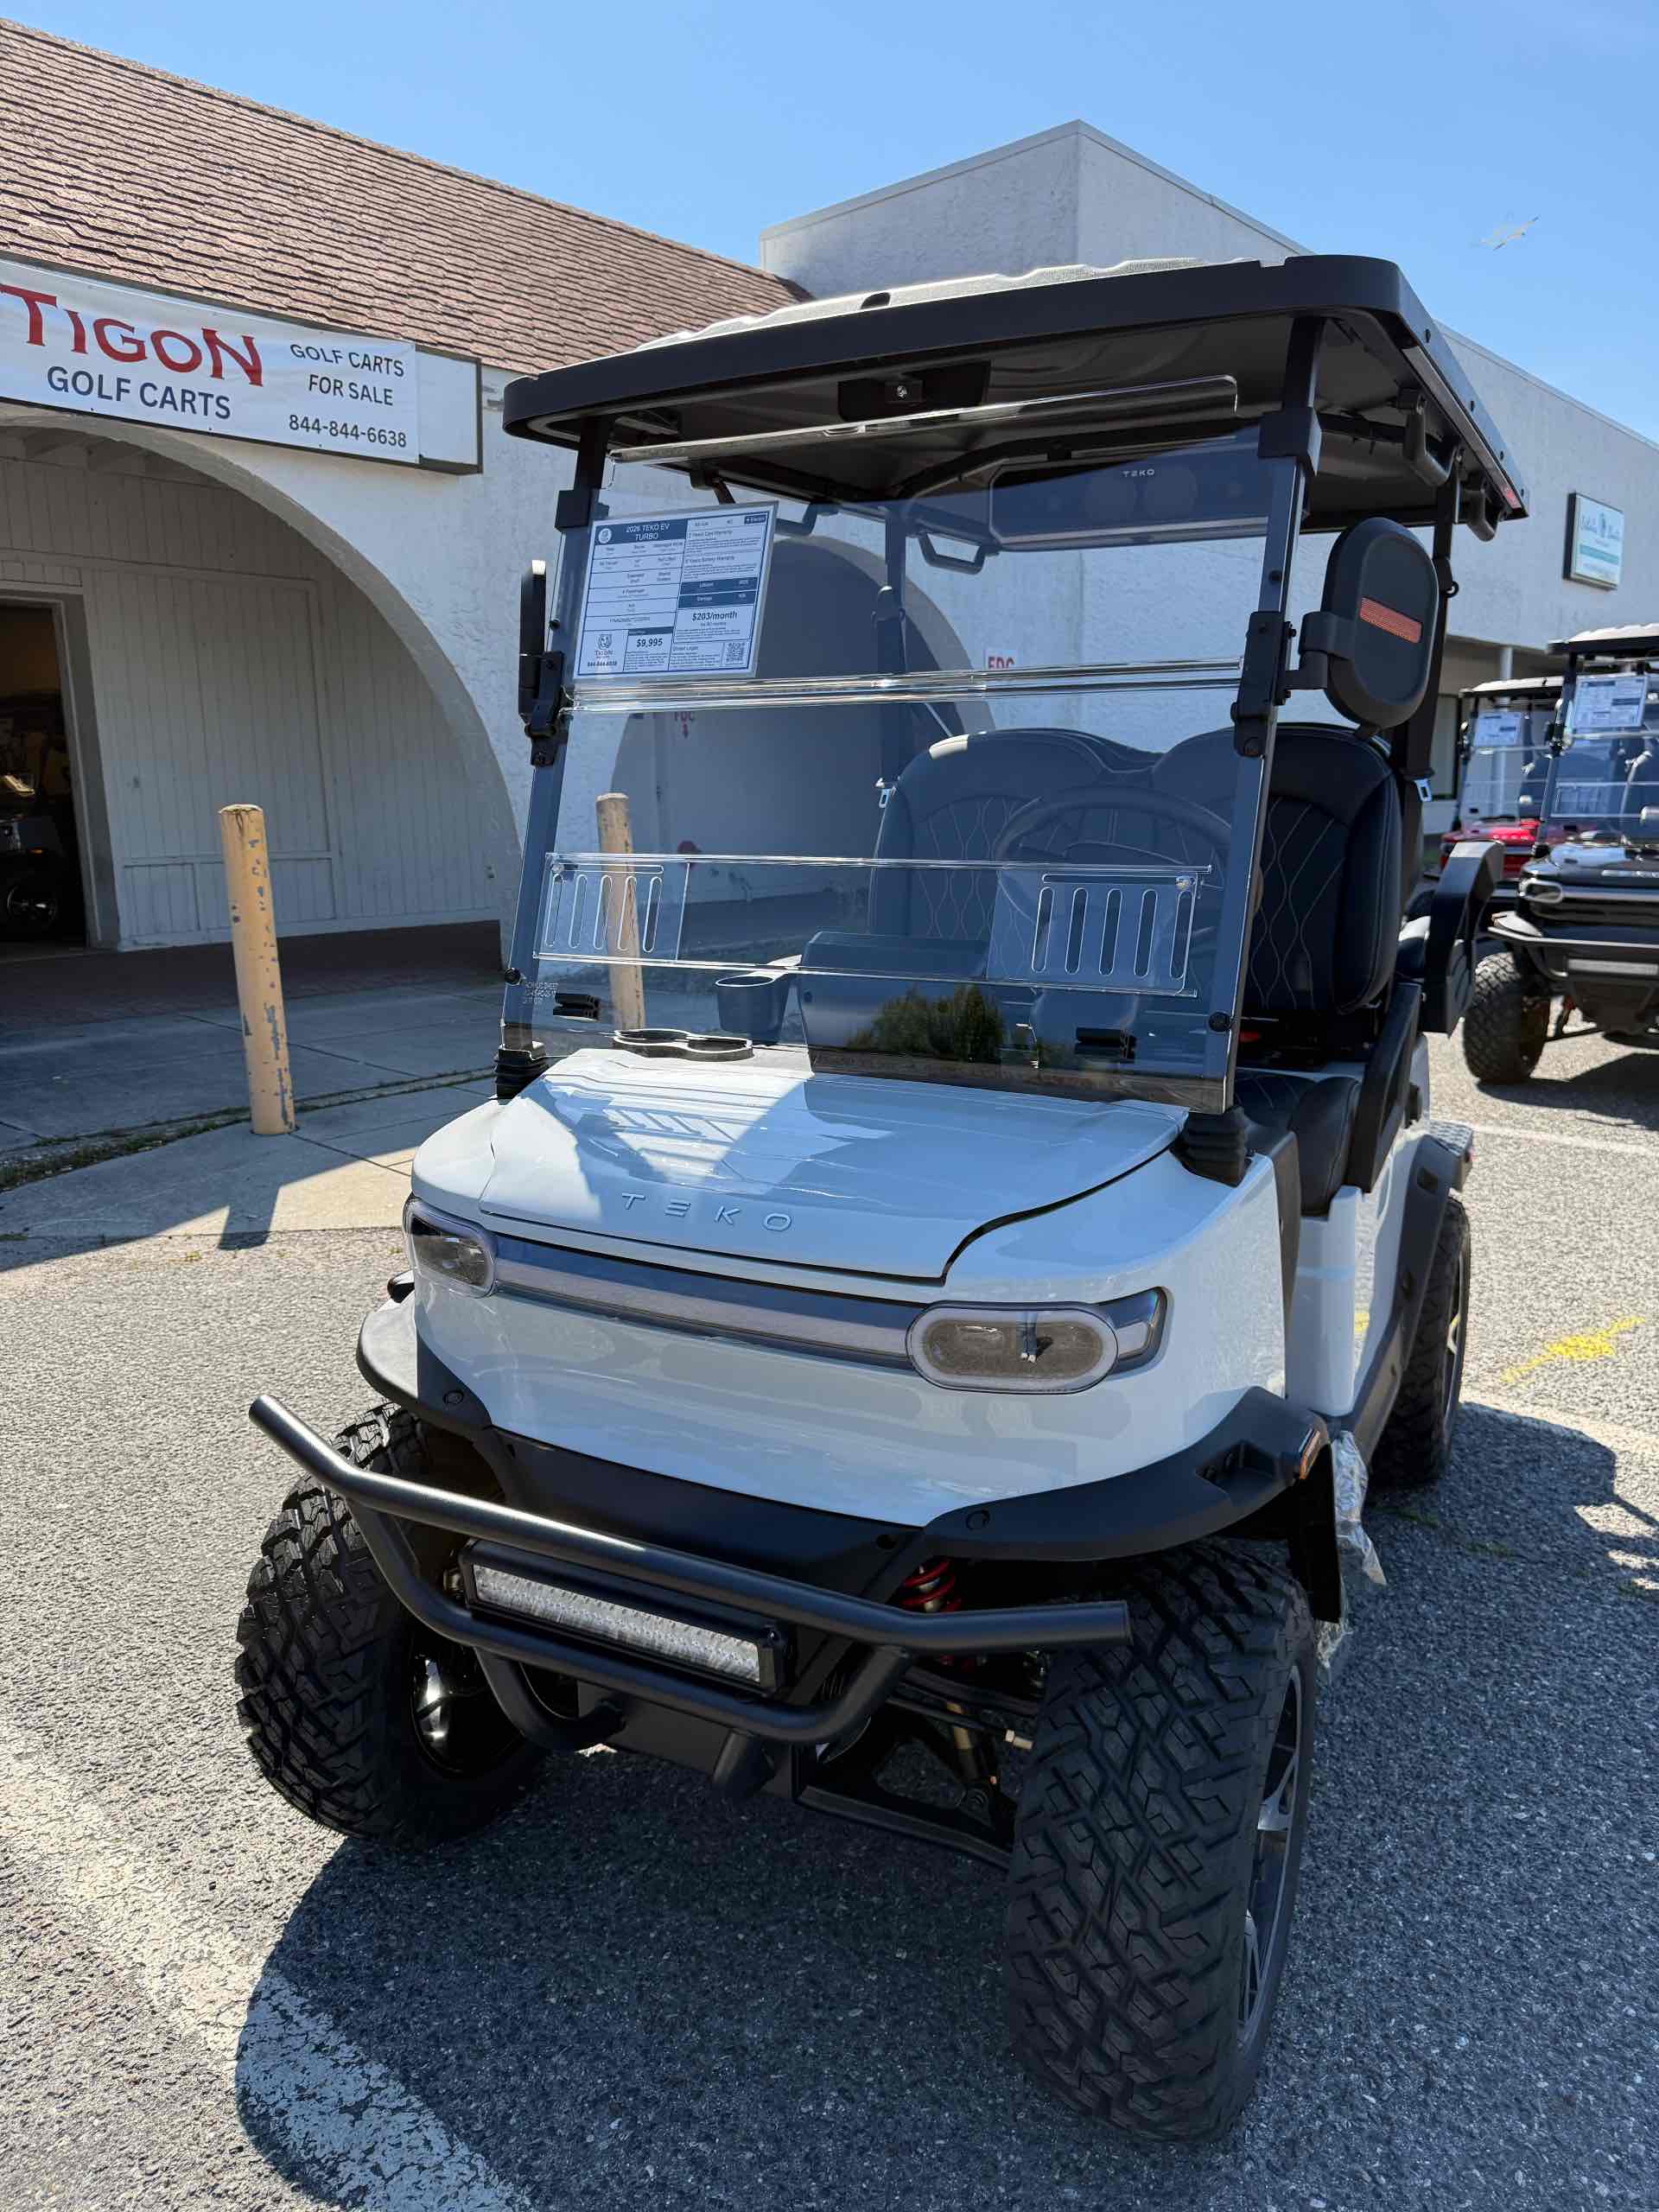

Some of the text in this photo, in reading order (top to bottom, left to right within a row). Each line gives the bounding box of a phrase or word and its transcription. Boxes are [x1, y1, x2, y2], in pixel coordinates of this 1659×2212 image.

[0, 283, 264, 386] TIGON
[290, 344, 404, 378] GOLF CARTS
[47, 365, 231, 420] GOLF CARTS
[308, 374, 393, 406] FOR SALE
[289, 414, 407, 448] 844-844-6638
[1122, 468, 1155, 478] TEKO
[635, 532, 658, 541] TURBO
[692, 610, 738, 621] $203/month
[636, 638, 663, 648] $9,995
[621, 1192, 792, 1232] TEKO
